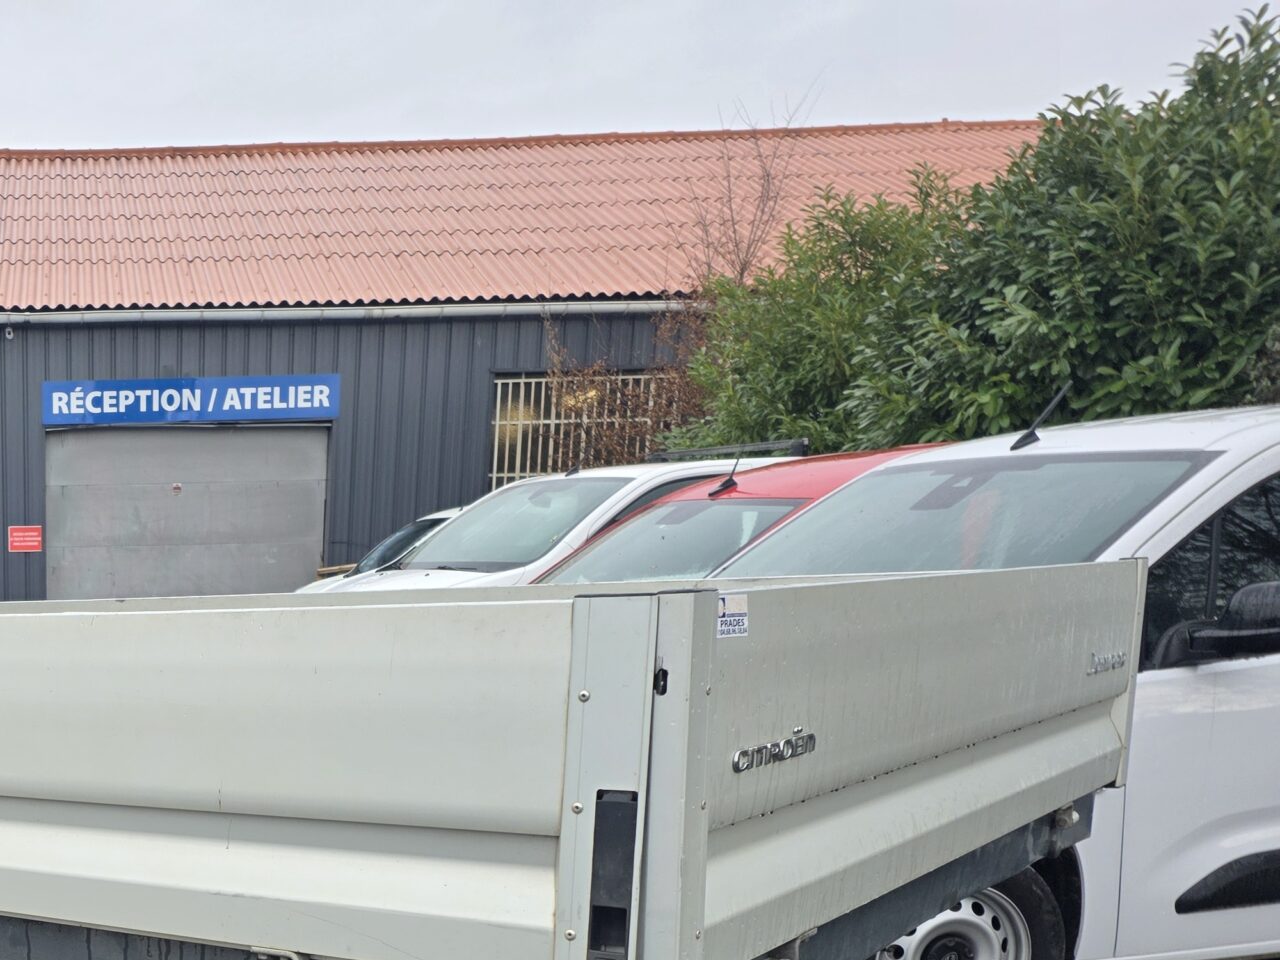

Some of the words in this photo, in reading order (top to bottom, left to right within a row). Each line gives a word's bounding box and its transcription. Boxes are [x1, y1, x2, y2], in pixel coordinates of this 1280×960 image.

[52, 387, 201, 414] RÉCEPTION
[208, 388, 218, 412] /
[222, 385, 330, 411] ATELIER
[720, 618, 745, 628] PRADES
